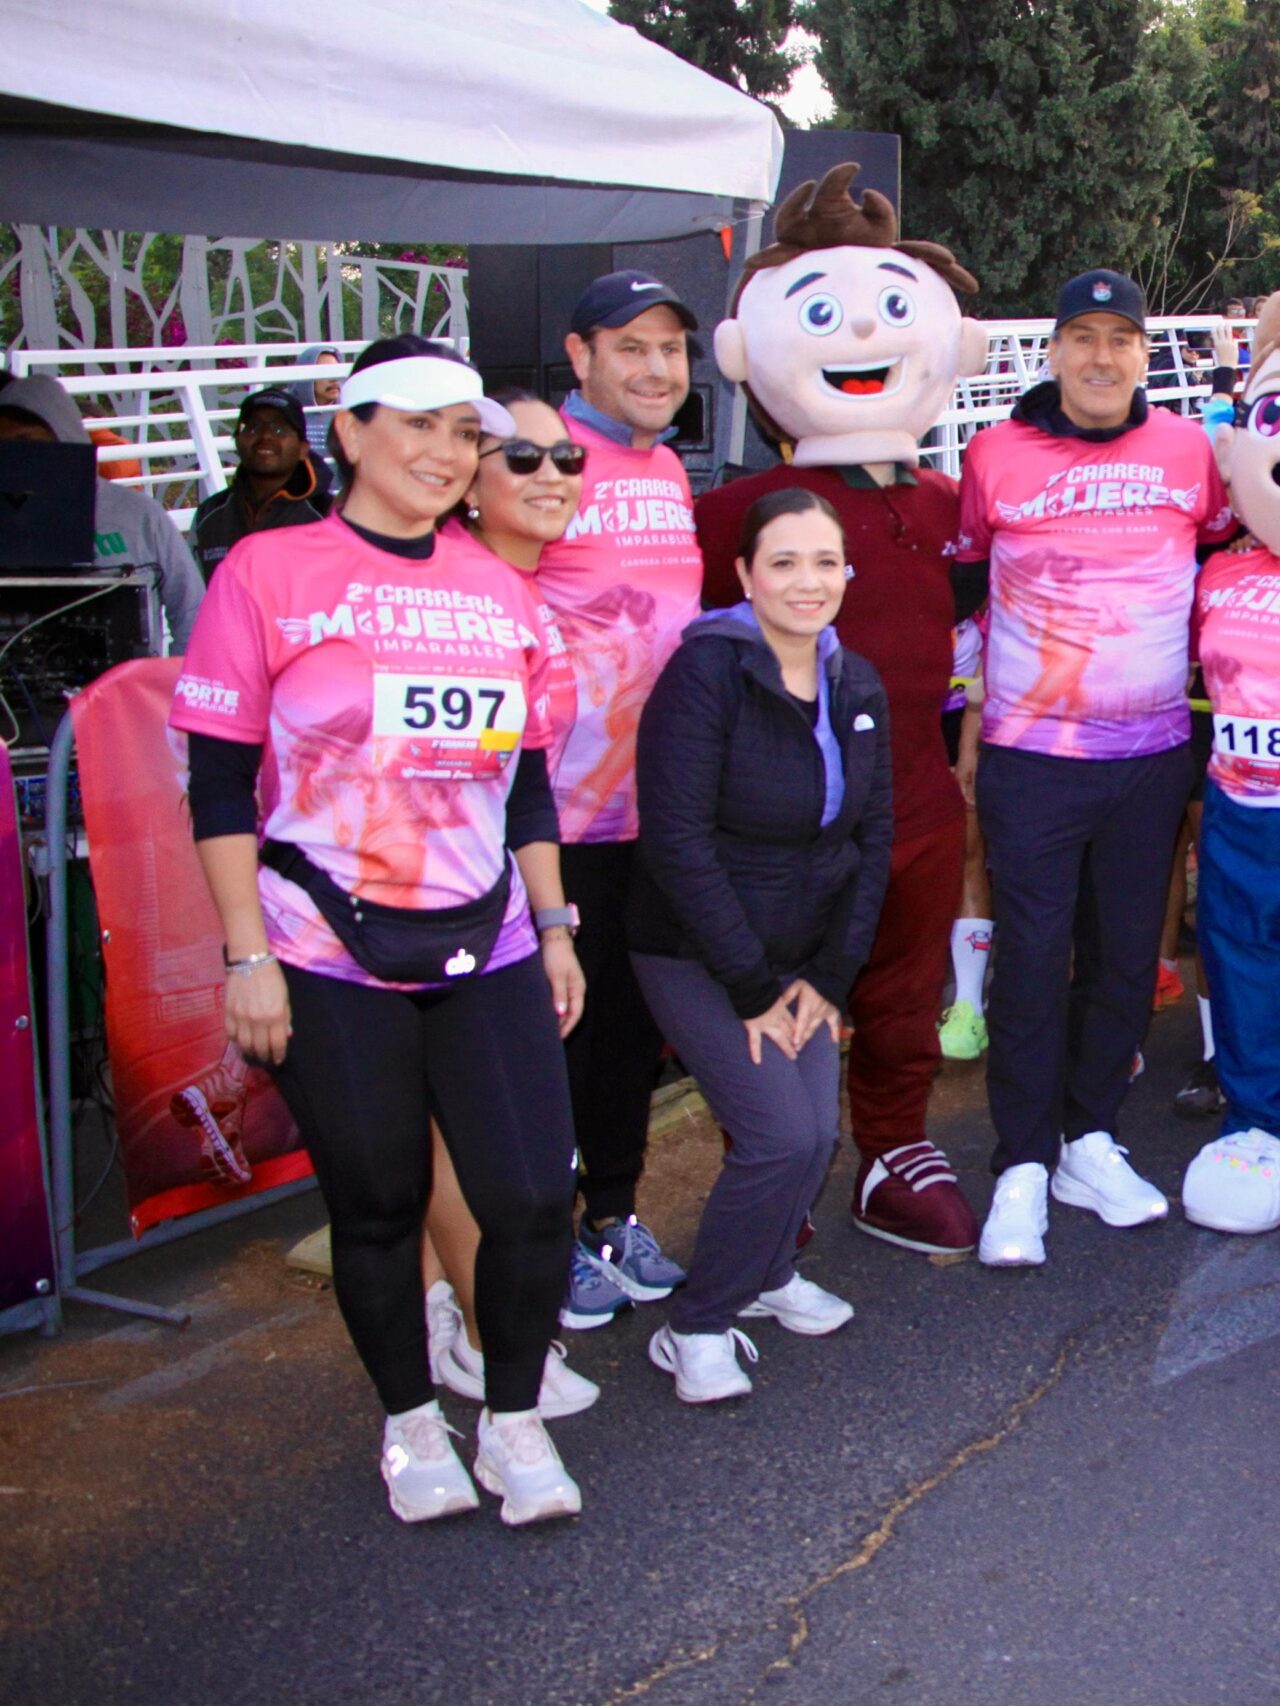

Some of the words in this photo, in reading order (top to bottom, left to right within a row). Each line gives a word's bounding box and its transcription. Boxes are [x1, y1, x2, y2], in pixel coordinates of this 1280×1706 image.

[1067, 464, 1165, 483] CARRERA
[1018, 482, 1194, 520] MUJERES
[374, 639, 505, 660] IMPARABLES
[402, 685, 505, 731] 597
